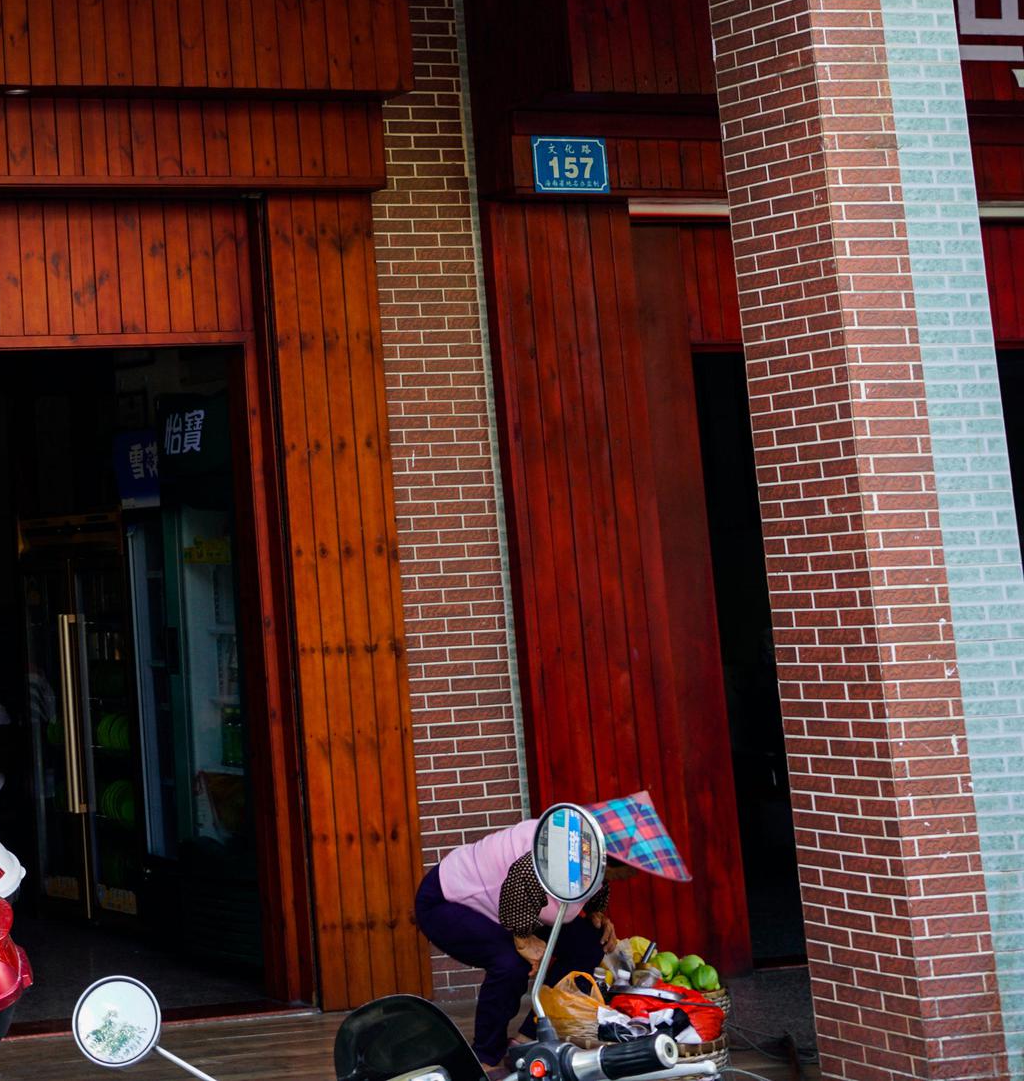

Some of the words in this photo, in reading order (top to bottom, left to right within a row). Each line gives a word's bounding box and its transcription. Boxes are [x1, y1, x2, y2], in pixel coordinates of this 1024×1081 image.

[547, 142, 592, 155] 文化路
[548, 156, 594, 179] 157
[164, 408, 206, 456] 怡寶
